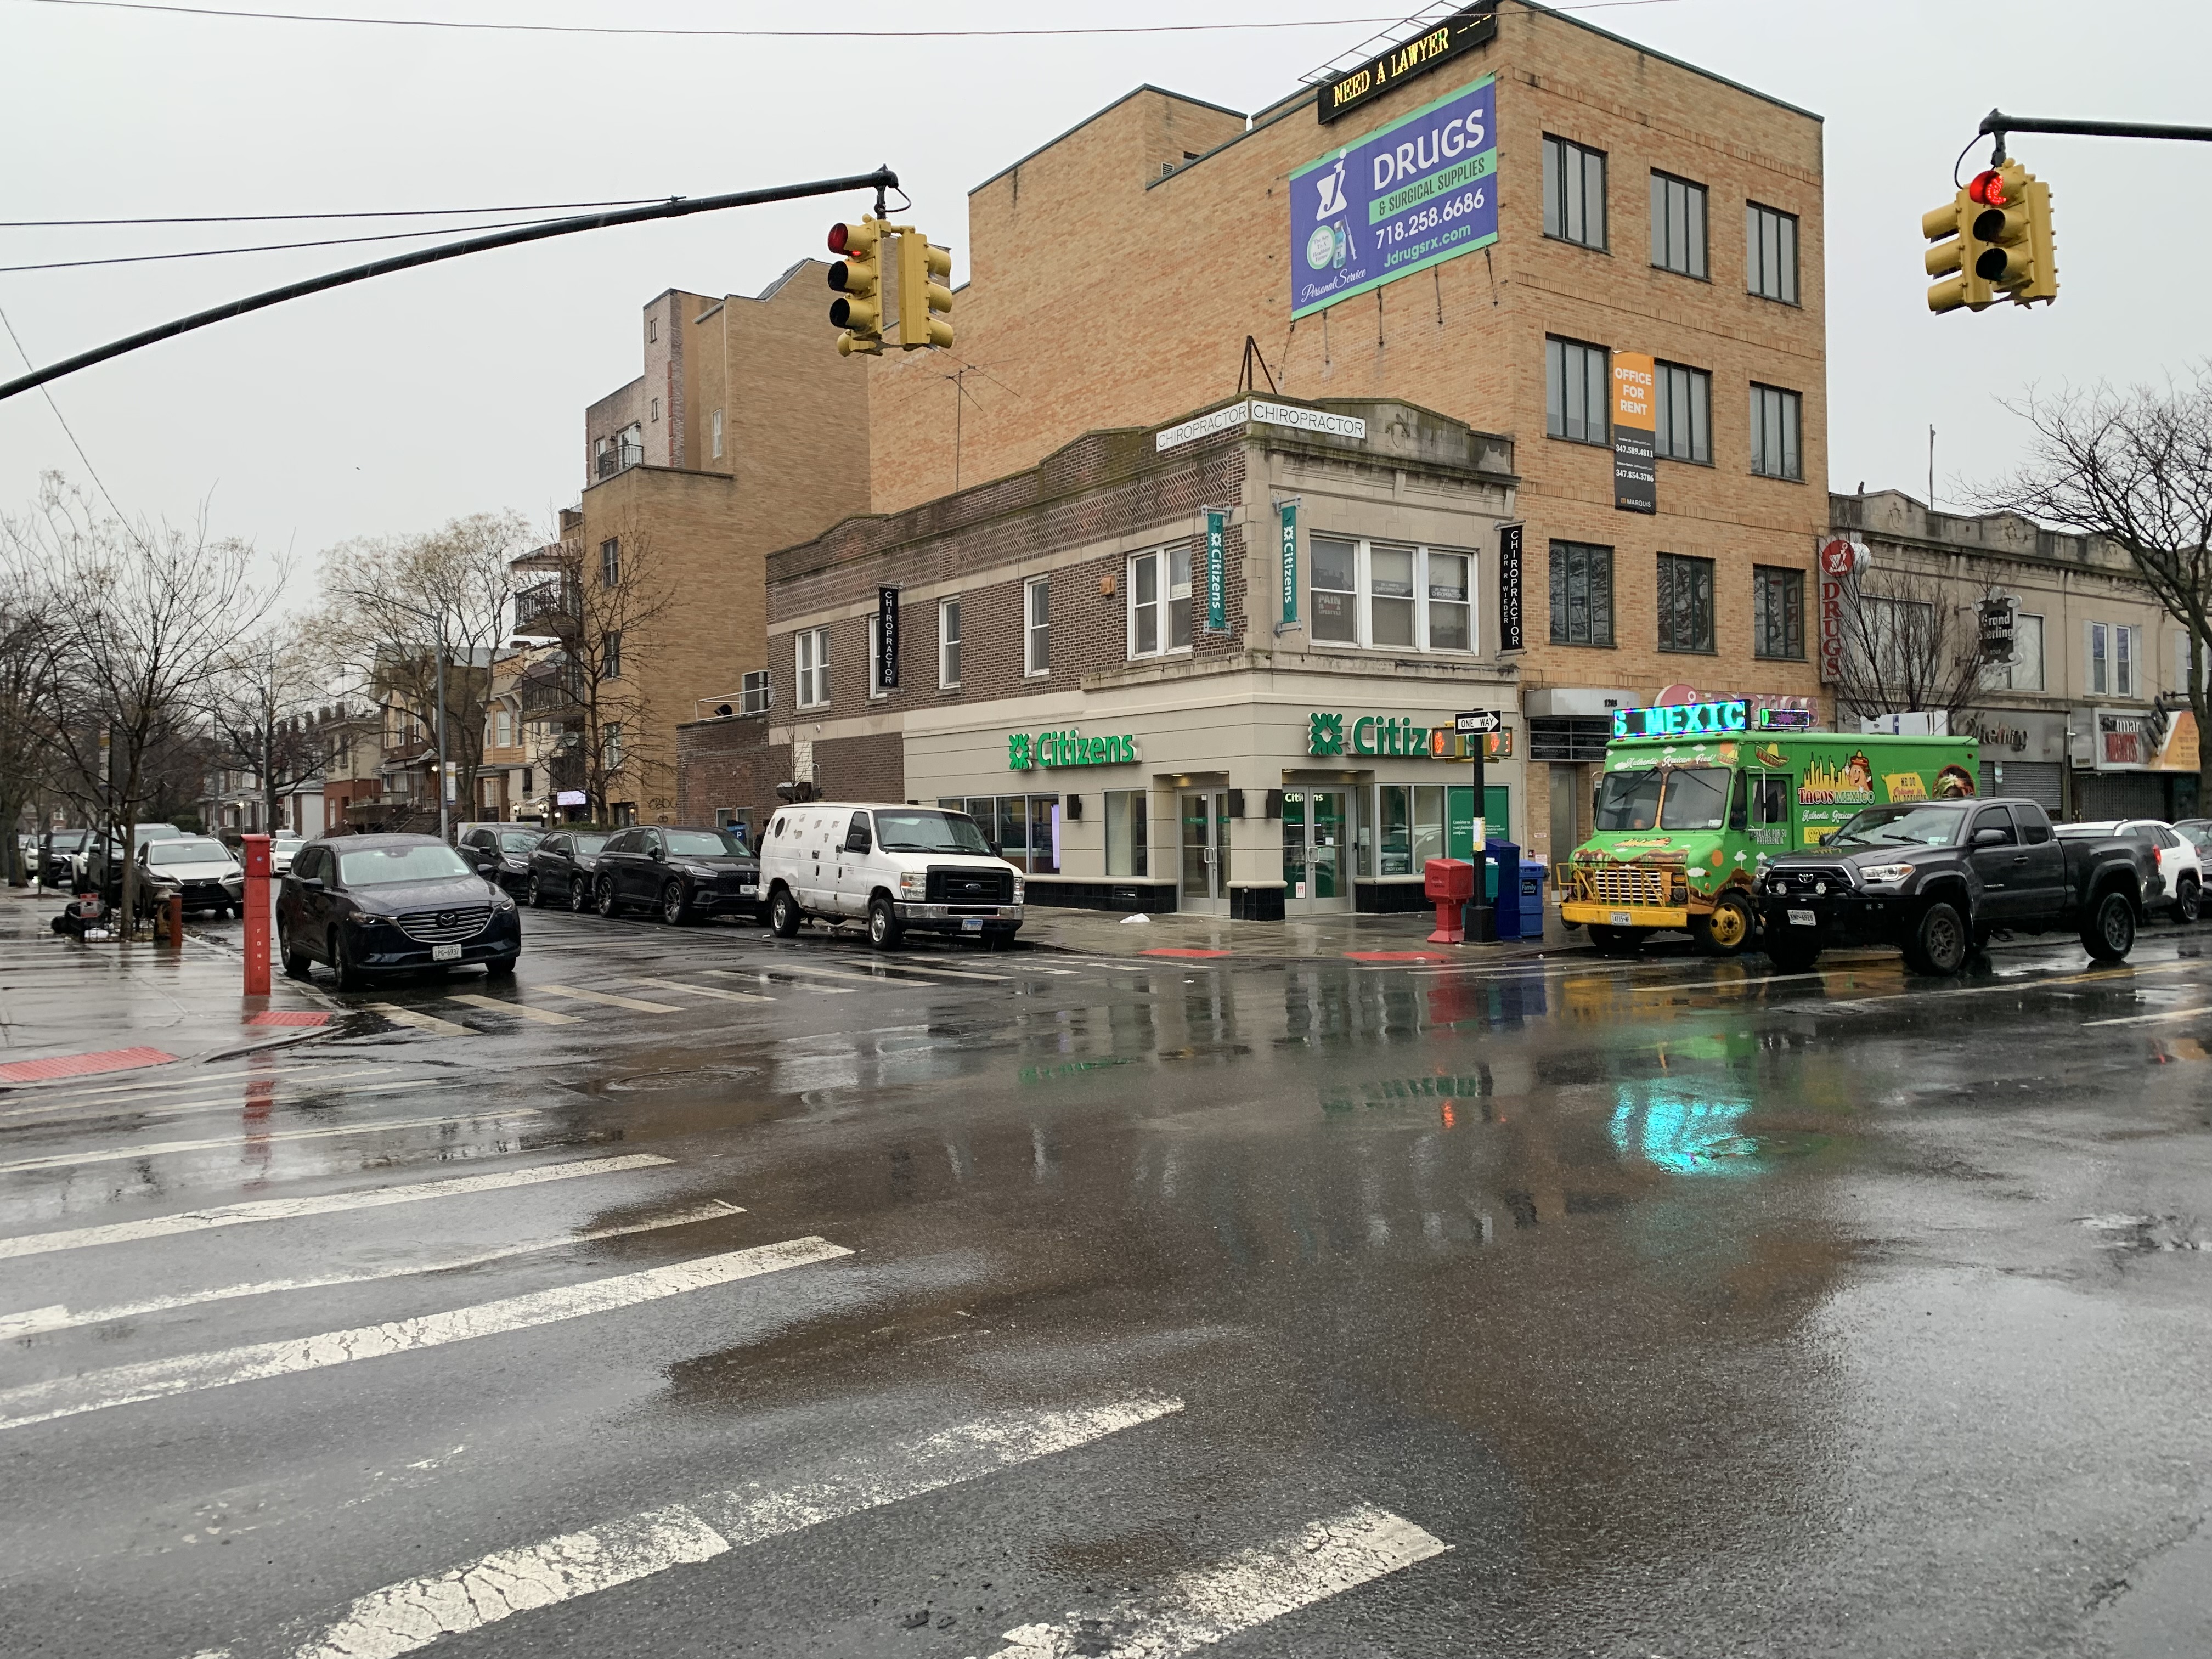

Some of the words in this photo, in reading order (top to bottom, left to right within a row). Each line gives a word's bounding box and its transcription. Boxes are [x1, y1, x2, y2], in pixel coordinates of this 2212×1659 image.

[1333, 70, 1370, 107] NEED
[1376, 61, 1386, 84] A
[1391, 27, 1449, 77] LAWYER
[1374, 109, 1485, 190] DRUGS
[1379, 201, 1386, 216] &
[1389, 179, 1435, 211] SURGICAL
[1438, 157, 1485, 190] SUPPLIES
[1376, 188, 1485, 249] 718.258.6686
[1384, 224, 1471, 267] Jdrugsrx.com
[1301, 276, 1339, 302] Personal
[1338, 268, 1366, 289] Service
[1615, 367, 1652, 386] OFFICE
[1623, 385, 1644, 399] FOR
[1254, 405, 1363, 435] CHIROPRACTOR
[1620, 399, 1647, 415] RENT
[1158, 405, 1247, 448] CHIROPRACTOR
[1616, 444, 1654, 458] 347.589.4811
[1616, 469, 1654, 482] 347.854.3786
[1627, 498, 1651, 508] MARQUIS
[1284, 543, 1294, 603] Citizens
[1503, 554, 1508, 566] DR
[1211, 549, 1222, 608] Citizens
[1510, 530, 1519, 645] CHIROPRACTOR
[1318, 595, 1341, 605] PAIN
[885, 591, 893, 684] CHIROPRACTOR
[1822, 582, 1842, 676] DRUGS
[1462, 719, 1474, 728] ONE
[1480, 718, 1494, 726] WAY
[1645, 703, 1743, 734] MEXIC
[1036, 730, 1136, 767] Citizens
[1798, 787, 1833, 805] TACOS
[1835, 790, 1875, 805] MEXICO
[1901, 777, 1908, 786] WE
[1909, 777, 1916, 786] DO
[1802, 810, 1829, 822] Authentic
